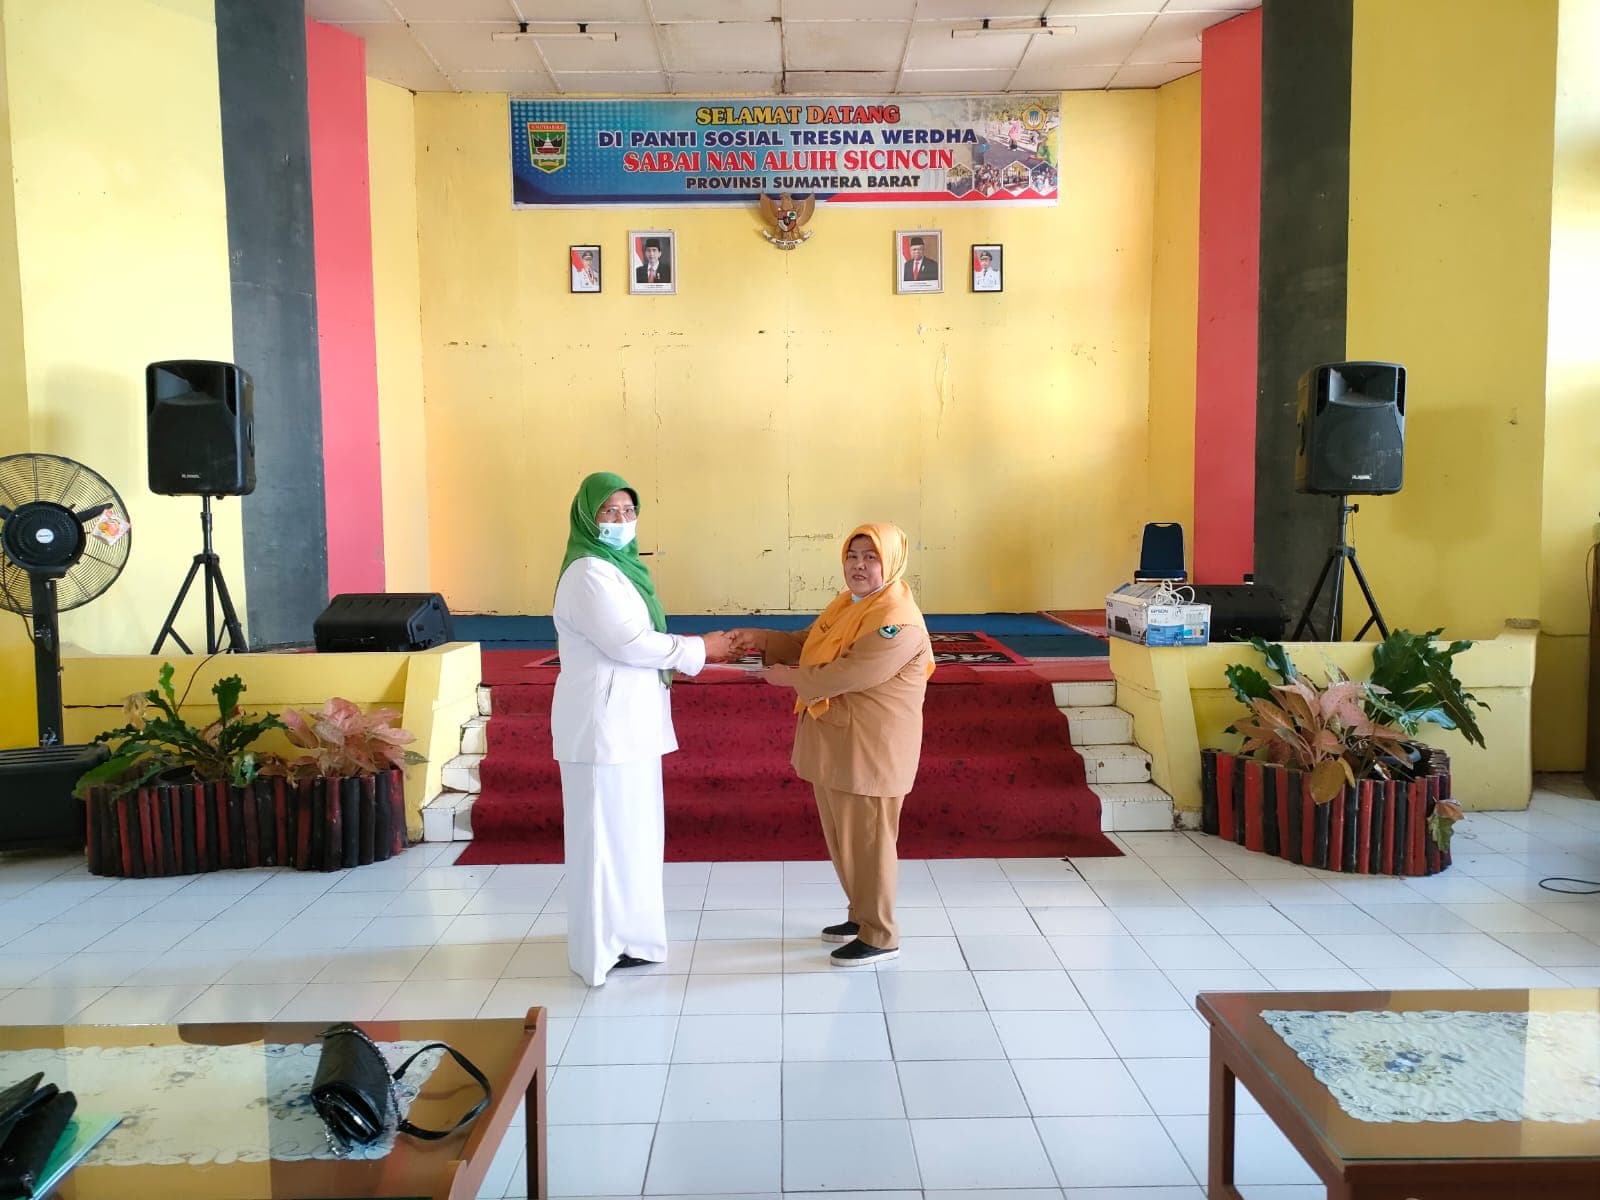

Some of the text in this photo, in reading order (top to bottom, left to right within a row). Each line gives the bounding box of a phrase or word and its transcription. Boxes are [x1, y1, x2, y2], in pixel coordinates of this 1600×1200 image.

[696, 104, 901, 125] SELAMAT DATANG
[599, 128, 978, 147] DI PANTI SOSIAL TRESNA WERDHA
[623, 149, 954, 172] SABAI NAN ALUIH SICINCIN
[686, 175, 921, 189] PROVINSI SUMATERA BARAT
